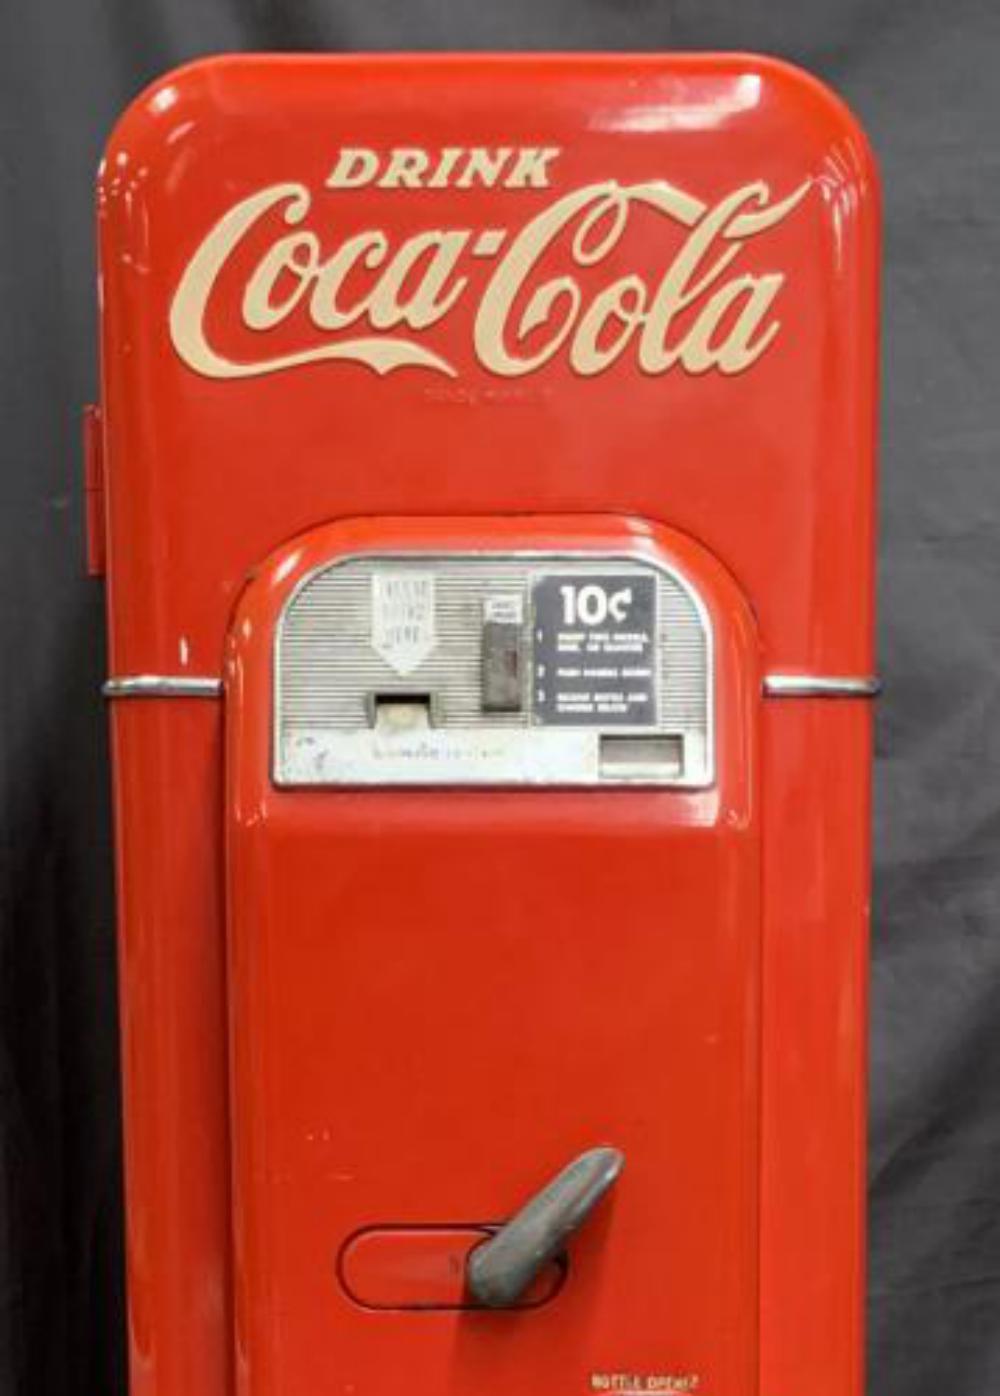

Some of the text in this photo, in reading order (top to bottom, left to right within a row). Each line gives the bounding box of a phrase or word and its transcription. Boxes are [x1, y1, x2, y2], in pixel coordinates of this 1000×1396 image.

[325, 147, 562, 189] DRINK
[168, 180, 814, 378] Coca-Cola
[560, 584, 633, 625] 10¢
